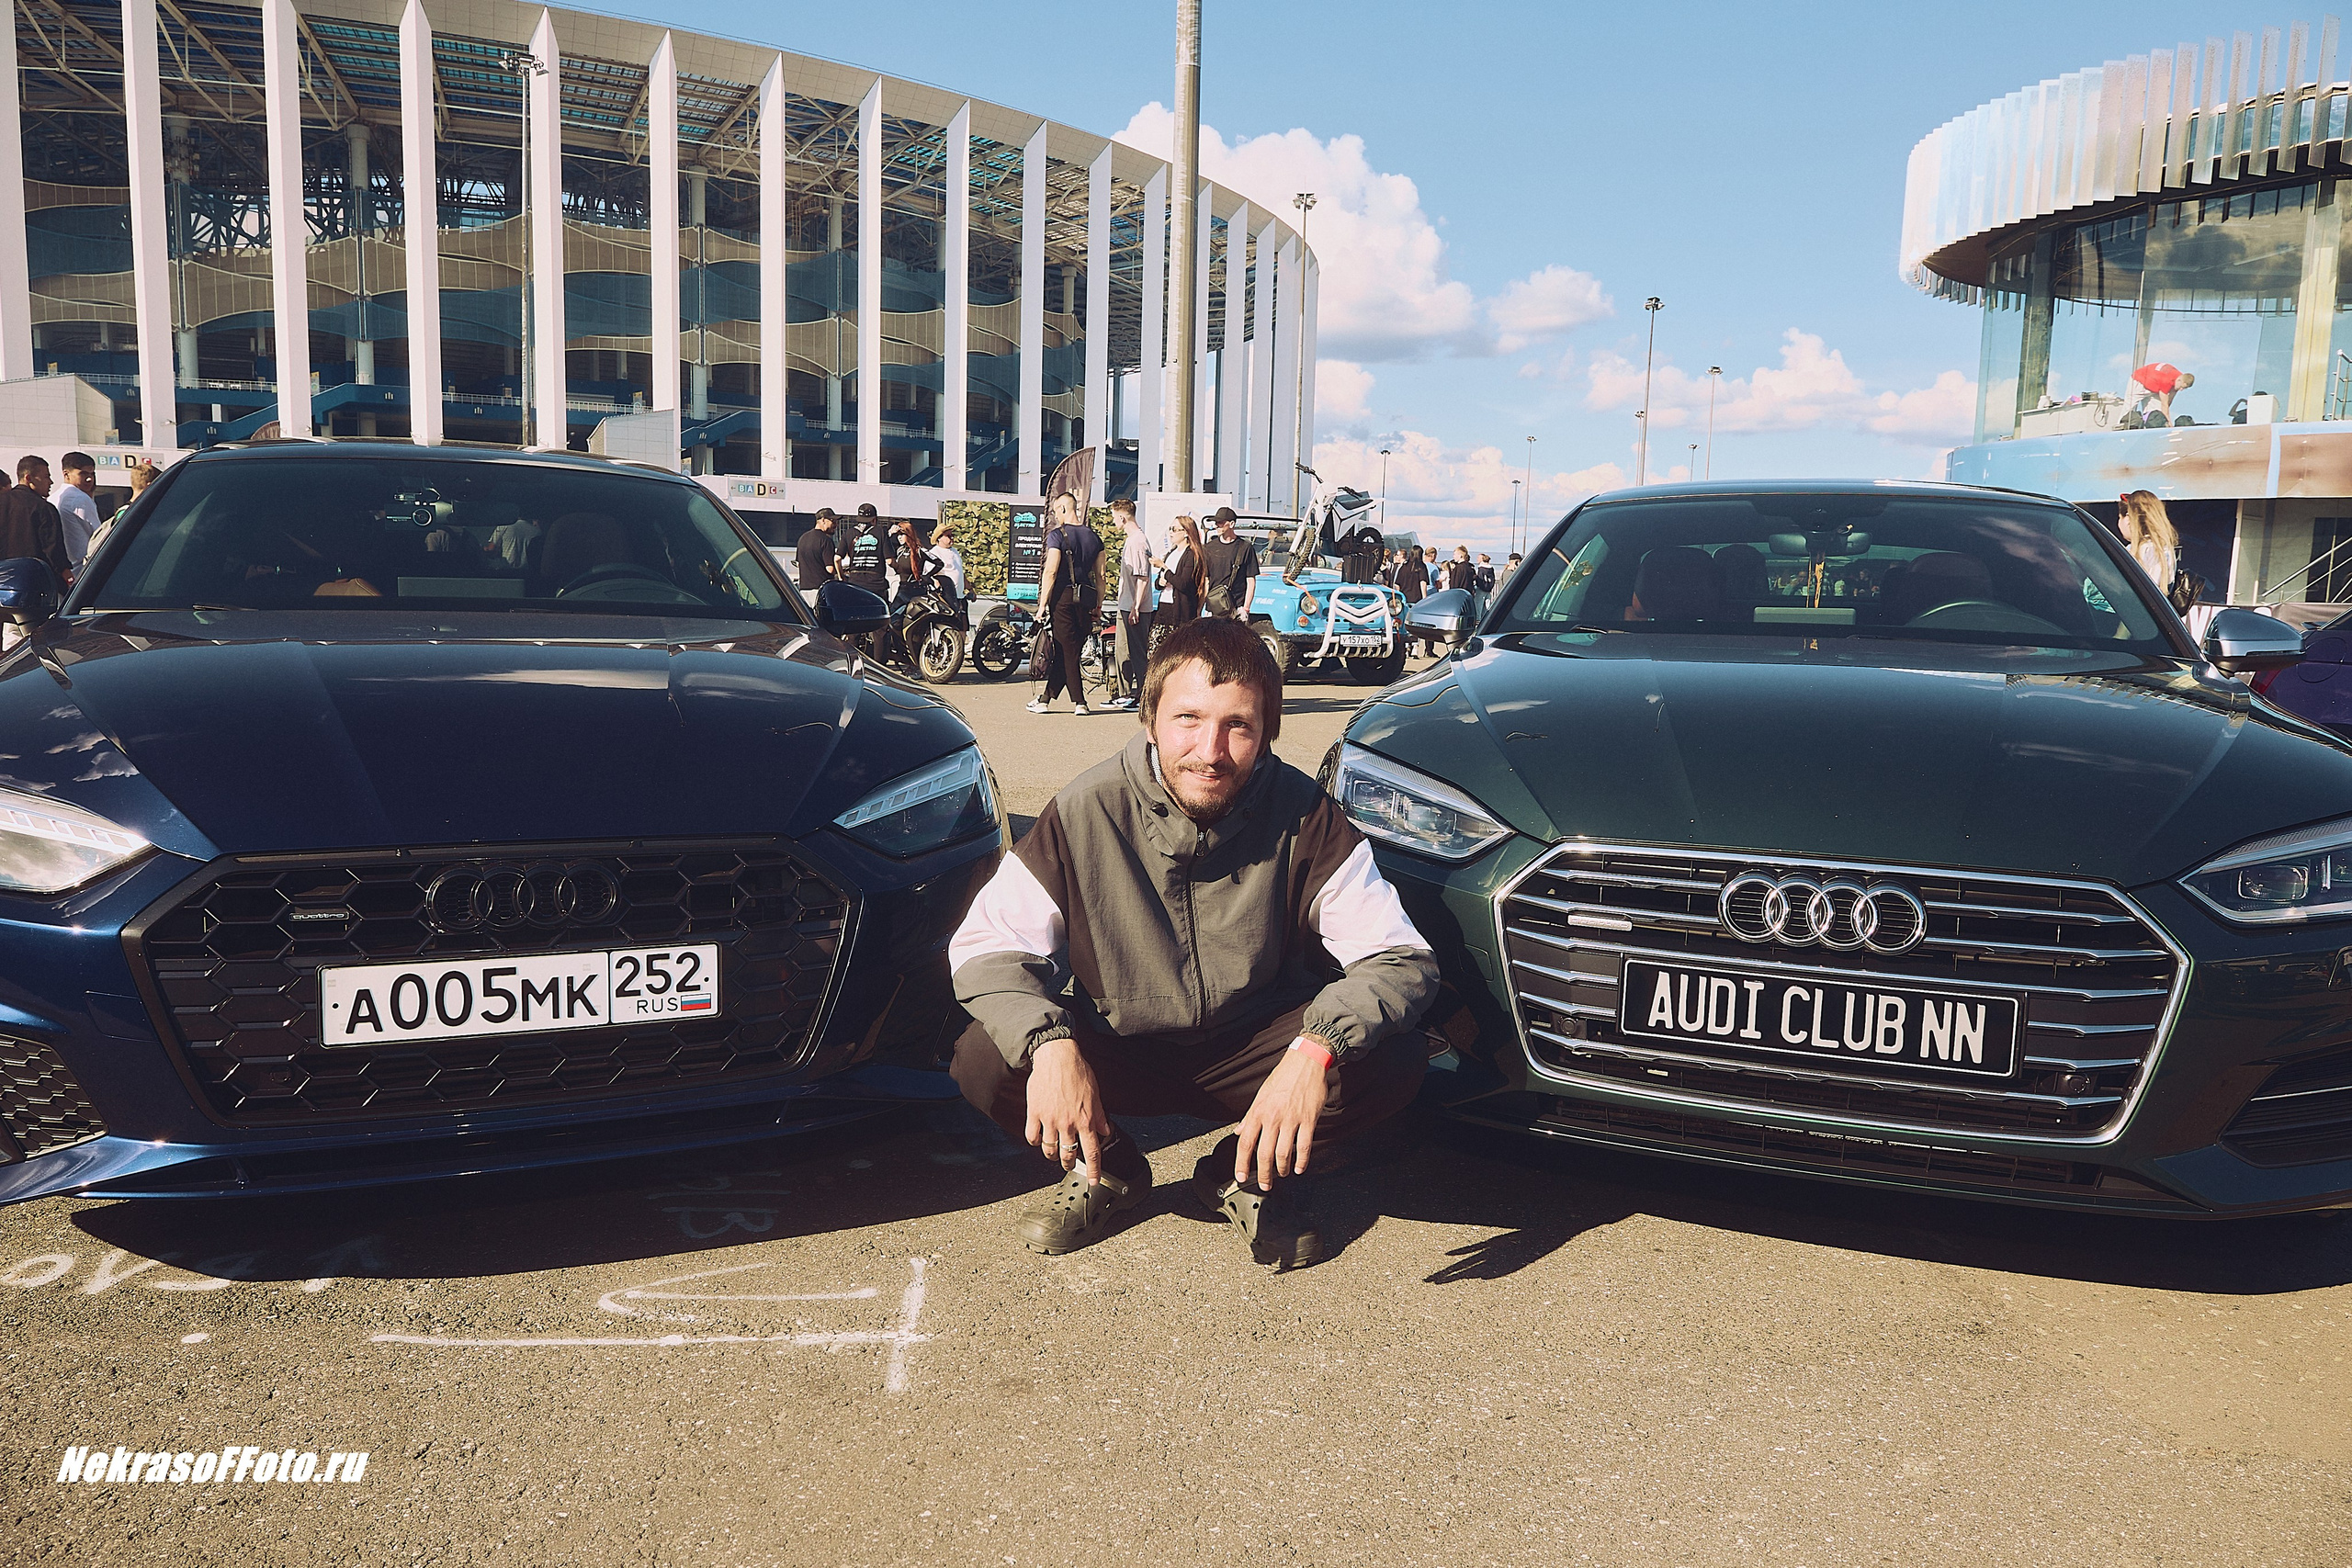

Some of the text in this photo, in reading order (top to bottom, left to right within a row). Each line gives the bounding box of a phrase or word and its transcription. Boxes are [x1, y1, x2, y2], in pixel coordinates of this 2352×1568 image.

[124, 455, 137, 468] D
[747, 485, 753, 493] A
[757, 483, 766, 496] D
[345, 952, 702, 1034] А005МК 252
[636, 997, 679, 1014] RUS
[1647, 970, 1986, 1065] AUDI CLUB NN
